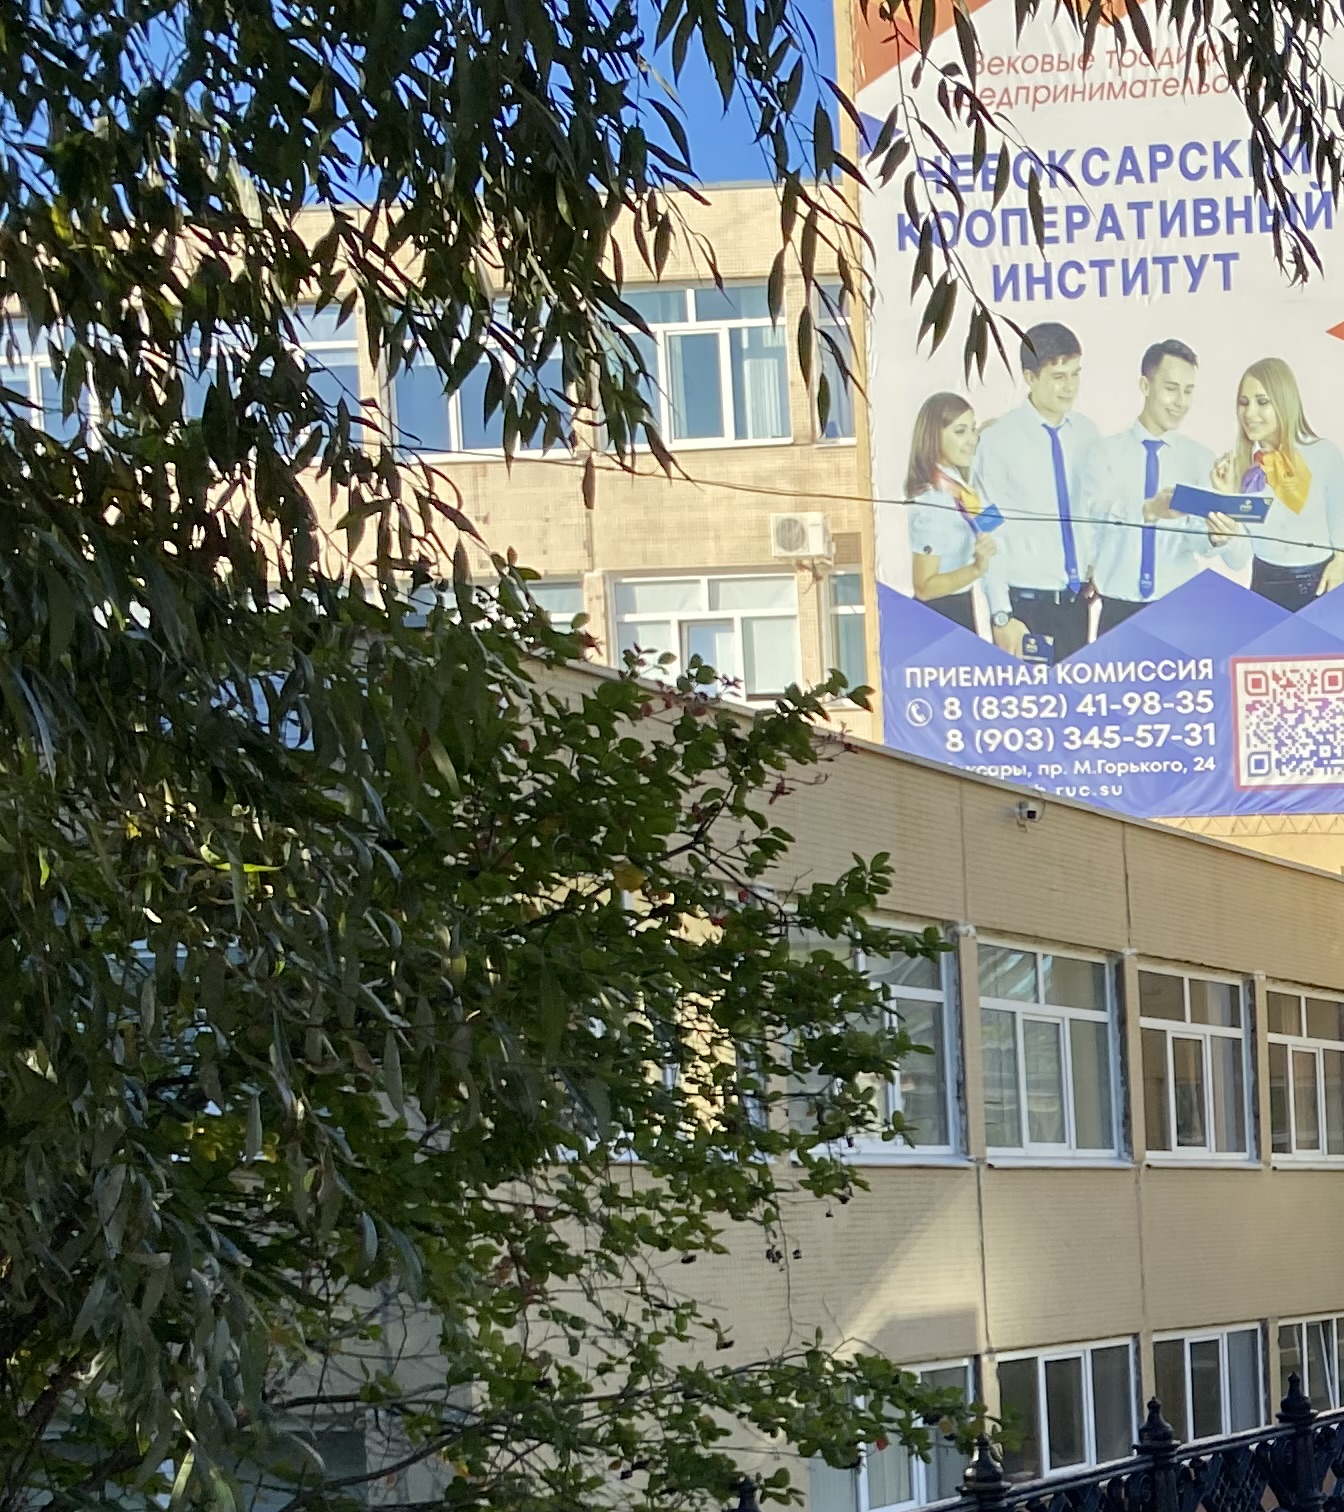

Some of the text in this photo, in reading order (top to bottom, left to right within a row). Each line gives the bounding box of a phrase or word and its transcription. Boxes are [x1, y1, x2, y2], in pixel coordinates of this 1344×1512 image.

[916, 126, 1312, 194] ЧЕБОКСАРСКЙ
[897, 181, 1333, 252] КООПЕРАТИВНЫЙ
[992, 251, 1240, 303] ИНСТИТУТ
[905, 657, 1214, 690] ПРИЕМНАЯ КОМИССИЯ
[943, 689, 1215, 724] 8 (8352) 41-98-35
[945, 722, 1217, 755] 8 (903) 345-57-31
[1037, 764, 1068, 779] пр.
[1193, 756, 1217, 772] 24
